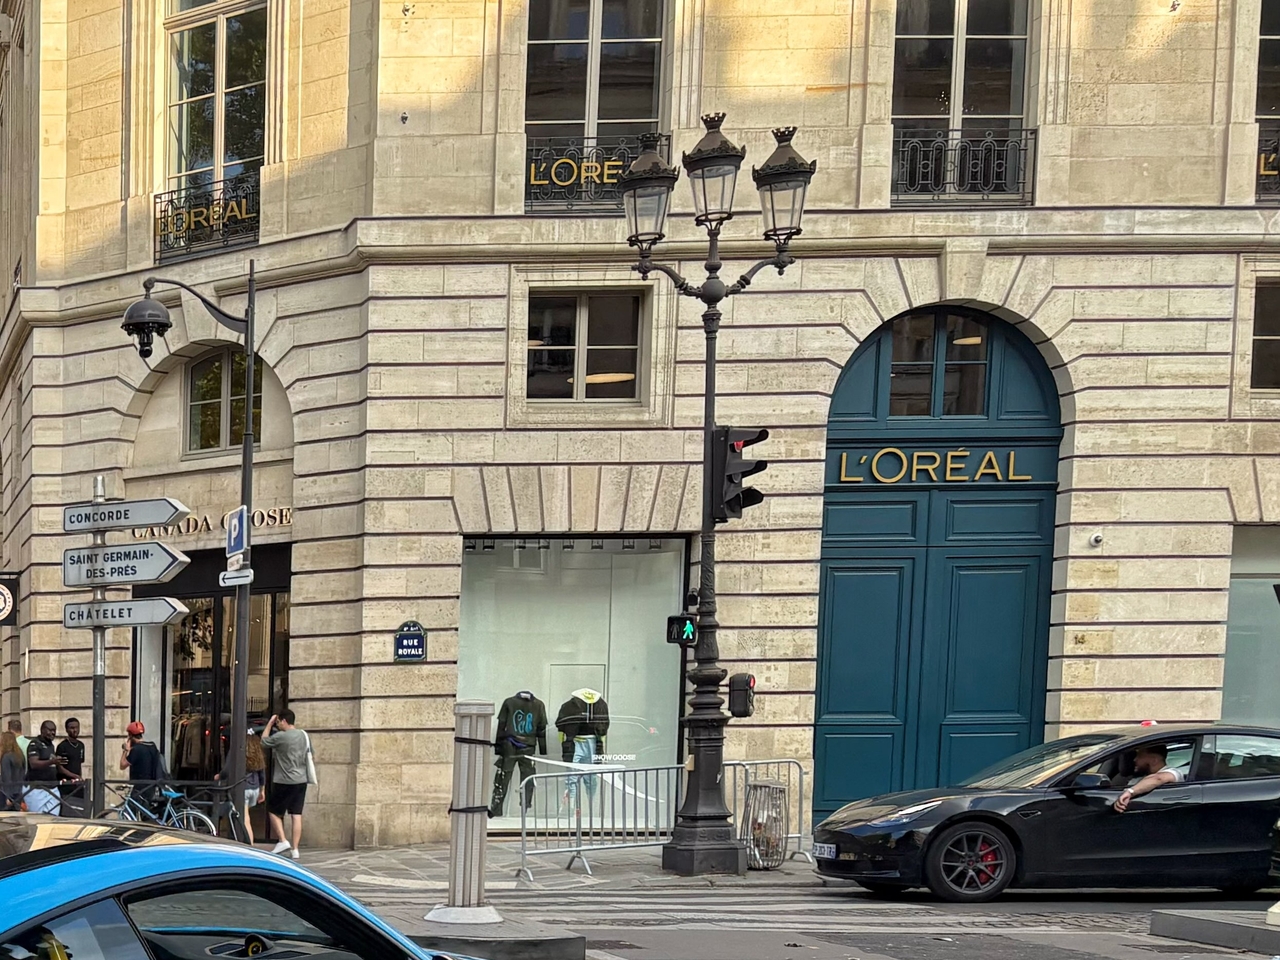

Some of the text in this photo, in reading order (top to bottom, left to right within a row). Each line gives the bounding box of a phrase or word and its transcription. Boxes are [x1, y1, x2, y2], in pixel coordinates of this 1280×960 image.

[530, 156, 623, 187] L'ORÉ
[840, 447, 1032, 483] L'ORÉAL
[69, 509, 130, 524] CONCORDE
[231, 517, 240, 546] P
[69, 549, 154, 566] SAINT GERMAIN-
[86, 564, 138, 579] DES-PRÉS
[69, 606, 133, 621] CHÂTELET
[402, 638, 419, 646] RUE
[398, 647, 423, 656] ROYALE
